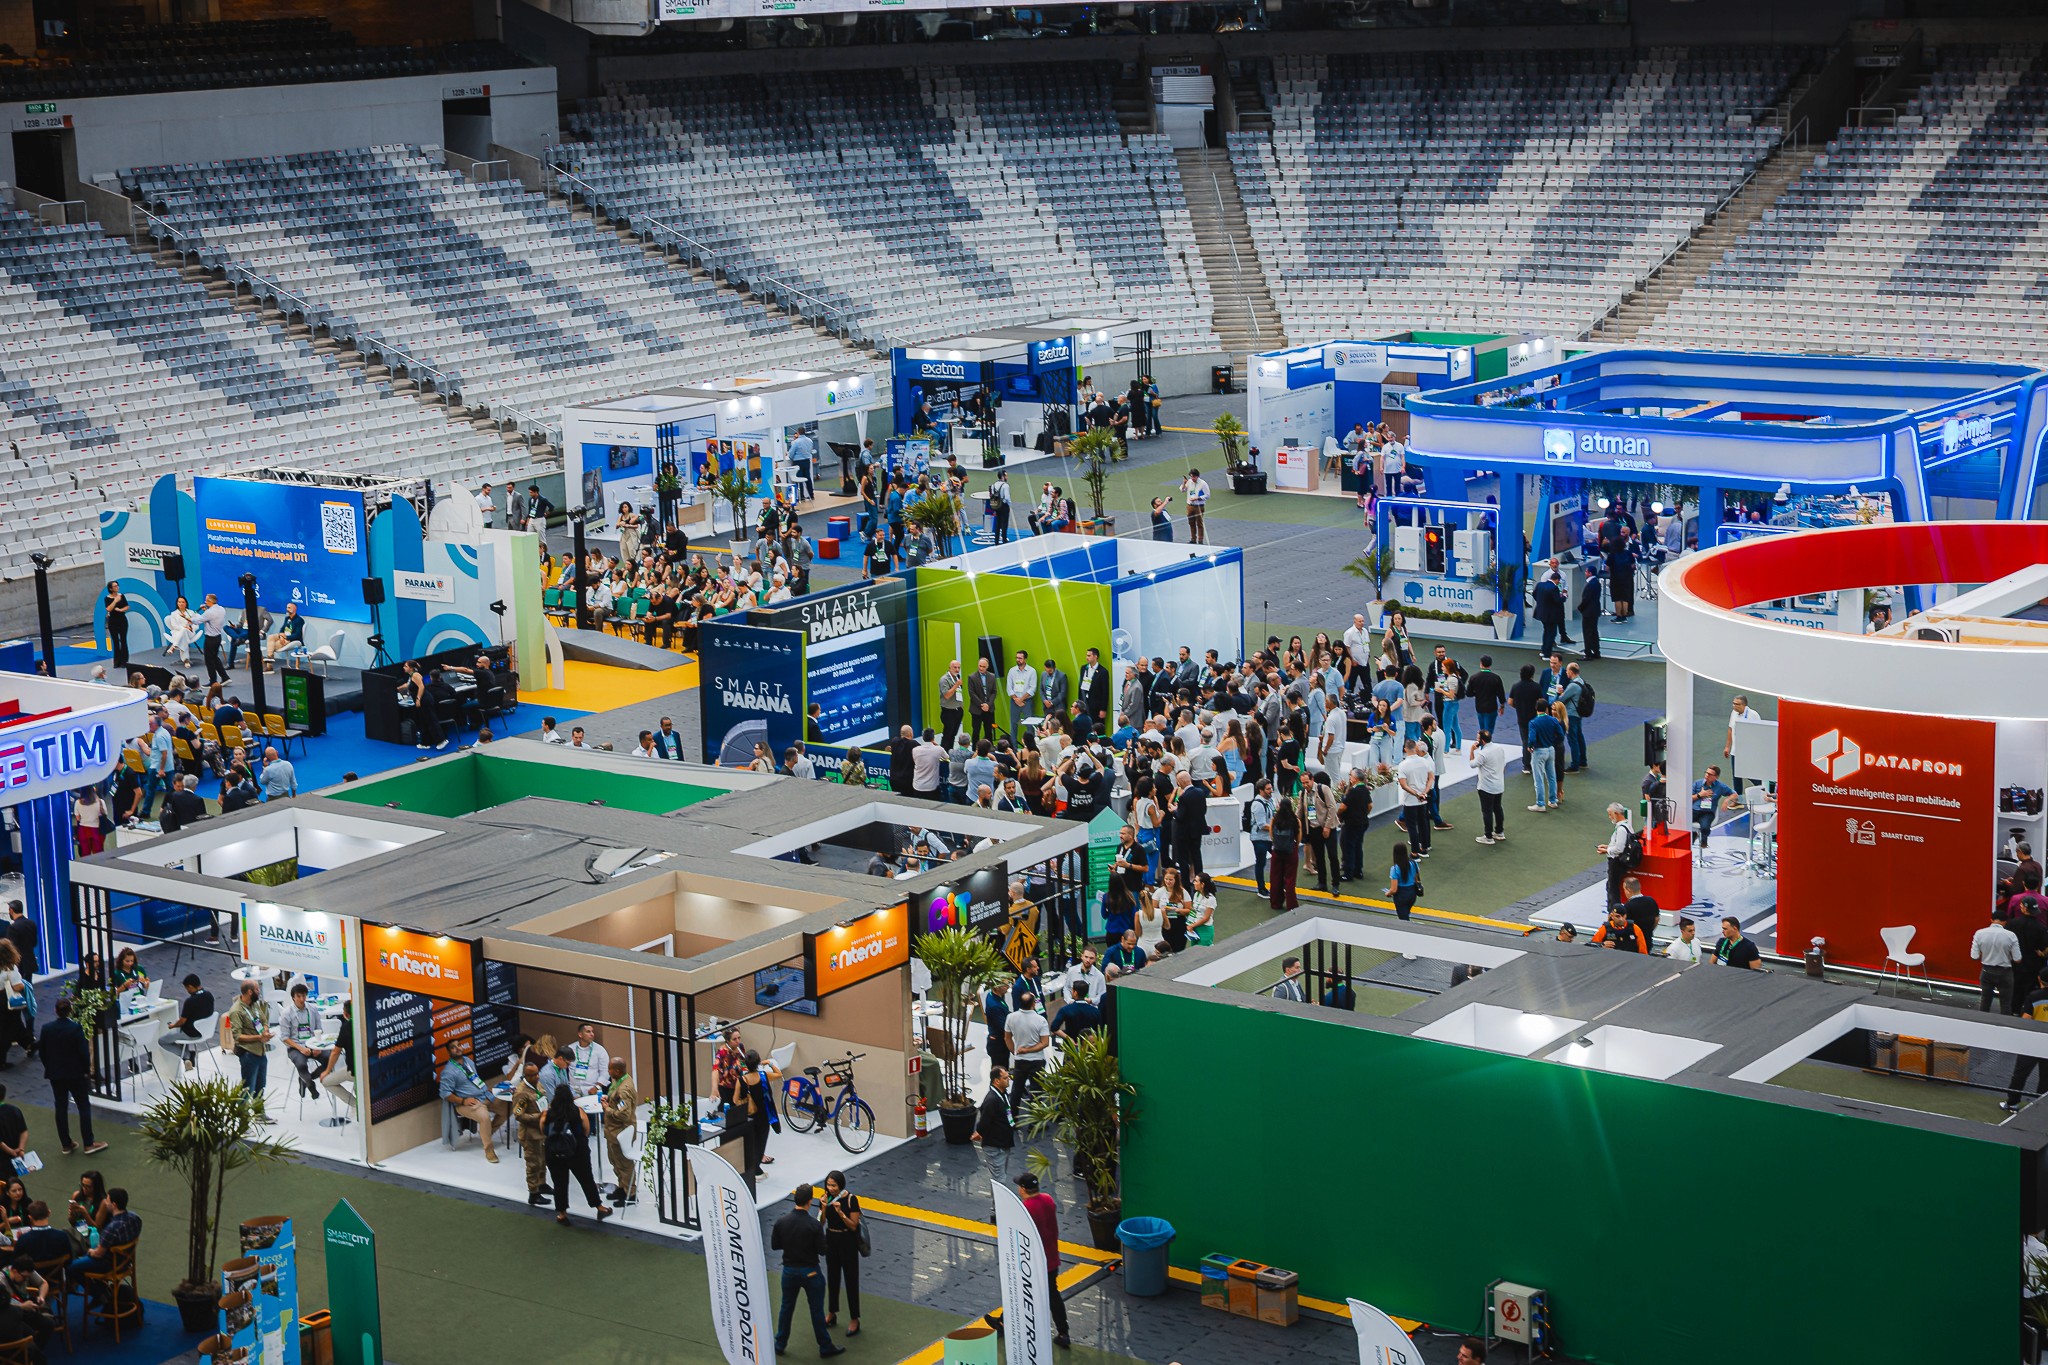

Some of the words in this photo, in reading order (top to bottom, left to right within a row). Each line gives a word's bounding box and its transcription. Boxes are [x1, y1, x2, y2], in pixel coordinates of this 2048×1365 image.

[1038, 345, 1069, 361] exatron
[921, 362, 964, 375] exatron
[927, 390, 957, 404] exatron
[1580, 432, 1650, 456] atman
[1613, 458, 1653, 470] systems
[207, 534, 233, 543] Plataforma
[234, 537, 249, 545] Digital
[208, 544, 253, 557] Maturidade
[254, 548, 292, 562] Municipal
[294, 553, 308, 562] DTI
[1428, 584, 1473, 600] atman
[801, 591, 871, 624] SMART
[1447, 601, 1473, 609] systems
[810, 601, 881, 642] PARANÁ
[714, 676, 783, 696] SMART
[723, 693, 793, 714] PARANÁ
[32, 724, 108, 778] TIM
[1864, 753, 1962, 777] DATAPROM
[1812, 783, 1848, 796] Soluções
[1849, 787, 1895, 801] inteligentes
[1896, 793, 1914, 804] para
[1915, 795, 1961, 809] mobilidade
[1880, 831, 1903, 841] SMART
[1904, 834, 1924, 843] CITIES
[260, 924, 314, 945] PARANÁ
[376, 1013, 402, 1028] MELHOR
[403, 1004, 424, 1018] LUGAR
[376, 1027, 393, 1038] PARA
[394, 1019, 414, 1032] VIVER,
[377, 1038, 390, 1049] SER
[390, 1031, 408, 1044] FELIZ
[408, 1029, 413, 1038] E
[326, 1228, 370, 1246] SMARTCITY
[722, 1186, 756, 1363] PROMETROPOLE
[1389, 1347, 1407, 1365] P
